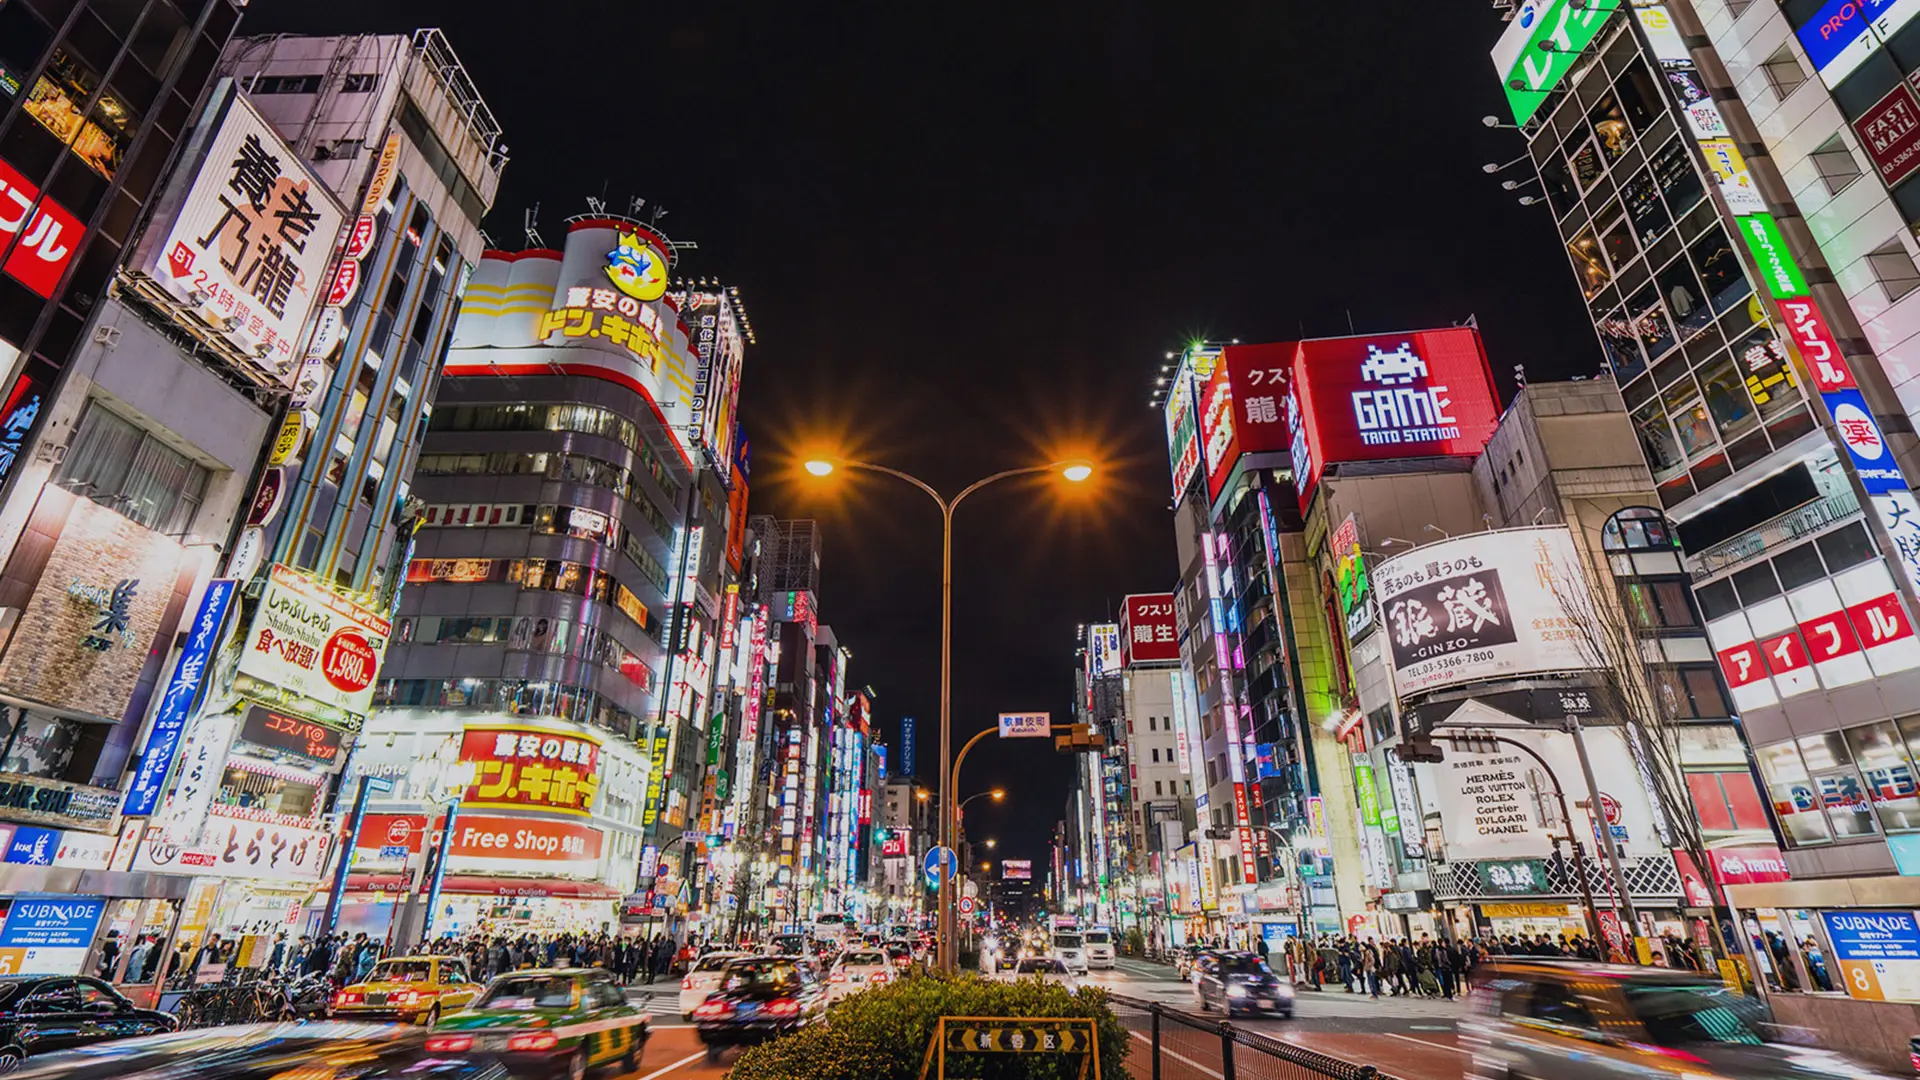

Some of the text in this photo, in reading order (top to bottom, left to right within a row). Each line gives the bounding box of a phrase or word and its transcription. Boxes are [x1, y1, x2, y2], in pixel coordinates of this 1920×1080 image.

[1691, 108, 1712, 120] HOT
[1866, 96, 1905, 139] FAST
[1875, 117, 1916, 154] NAIL
[230, 133, 322, 256] 養老
[174, 247, 194, 268] B1
[198, 194, 299, 320] 乃瀧
[192, 268, 292, 357] 24時間営業中
[565, 287, 664, 342] 驚安の殿
[1785, 303, 1846, 384] アイフル
[1248, 367, 1292, 385] クス
[1245, 396, 1286, 423] 龍
[1352, 386, 1456, 430] GAME
[1360, 427, 1460, 444] TAITO STATION
[1384, 555, 1483, 595] 売るのも 買うのも
[268, 588, 331, 633] しゃぶしゃぶ
[1137, 604, 1173, 617] クスリ
[1133, 624, 1179, 643] 龍生
[1730, 606, 1898, 681] アイフル
[325, 647, 364, 685] 1,980
[1408, 650, 1495, 677] TEL.03-5366-7800
[1461, 781, 1526, 795] LOUIS VUITTON
[1476, 793, 1516, 804] ROLEX
[1821, 767, 1917, 803] ミネドラ
[1476, 814, 1527, 826] BVLGARI
[1477, 804, 1519, 815] Cartier
[462, 828, 509, 849] Free
[514, 830, 558, 855] Shop
[1478, 825, 1529, 836] CHANEL
[222, 824, 314, 869] とらそば
[1745, 859, 1781, 873] TAITO
[17, 904, 97, 920] SUBNADE
[1832, 916, 1913, 933] SUBNADE
[1852, 968, 1869, 992] 8
[980, 1033, 1056, 1049] 新宿区
